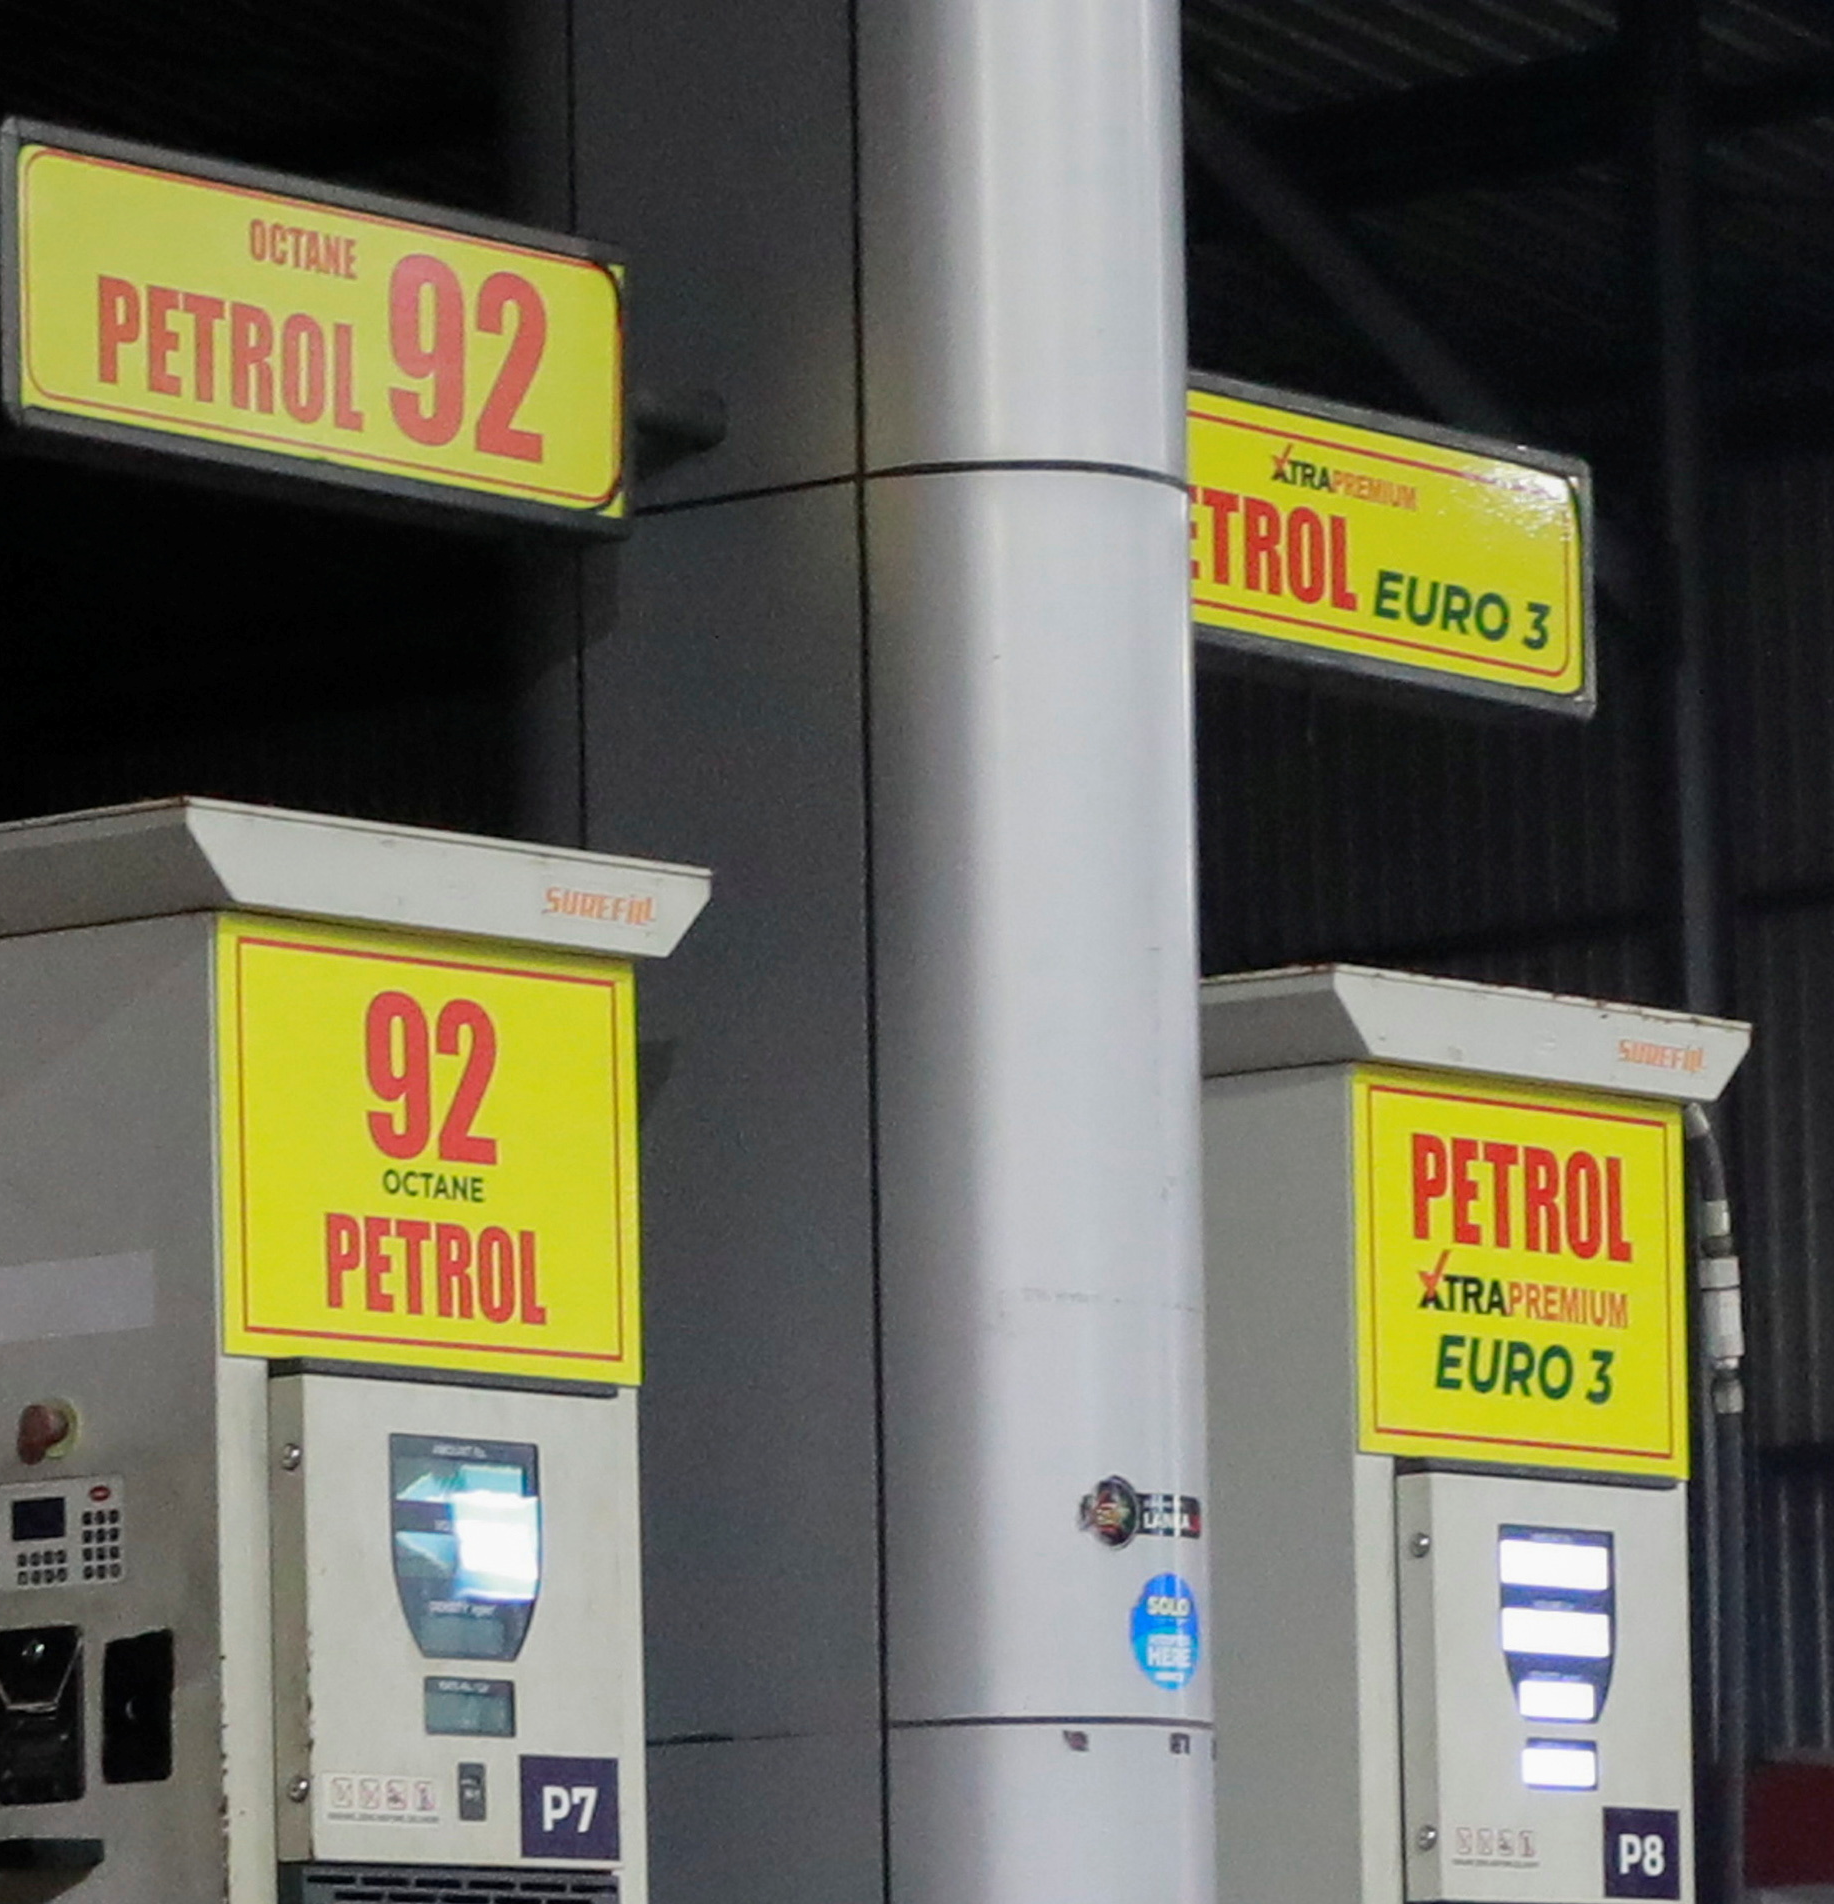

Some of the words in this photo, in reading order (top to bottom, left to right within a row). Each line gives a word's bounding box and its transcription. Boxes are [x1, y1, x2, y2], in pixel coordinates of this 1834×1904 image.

[248, 218, 358, 280] OCTANE
[97, 274, 364, 431] PETROL
[388, 254, 547, 463] 92
[1373, 569, 1511, 642] EURO
[1523, 602, 1551, 650] 3
[366, 990, 498, 1166] 92
[382, 1169, 485, 1202] OCTANE
[1411, 1132, 1633, 1263] PETROL
[326, 1212, 546, 1326] PETROL
[1436, 1333, 1575, 1399] EURO
[1585, 1349, 1614, 1405] 3
[542, 1785, 599, 1834] P7
[1618, 1833, 1666, 1878] P8
